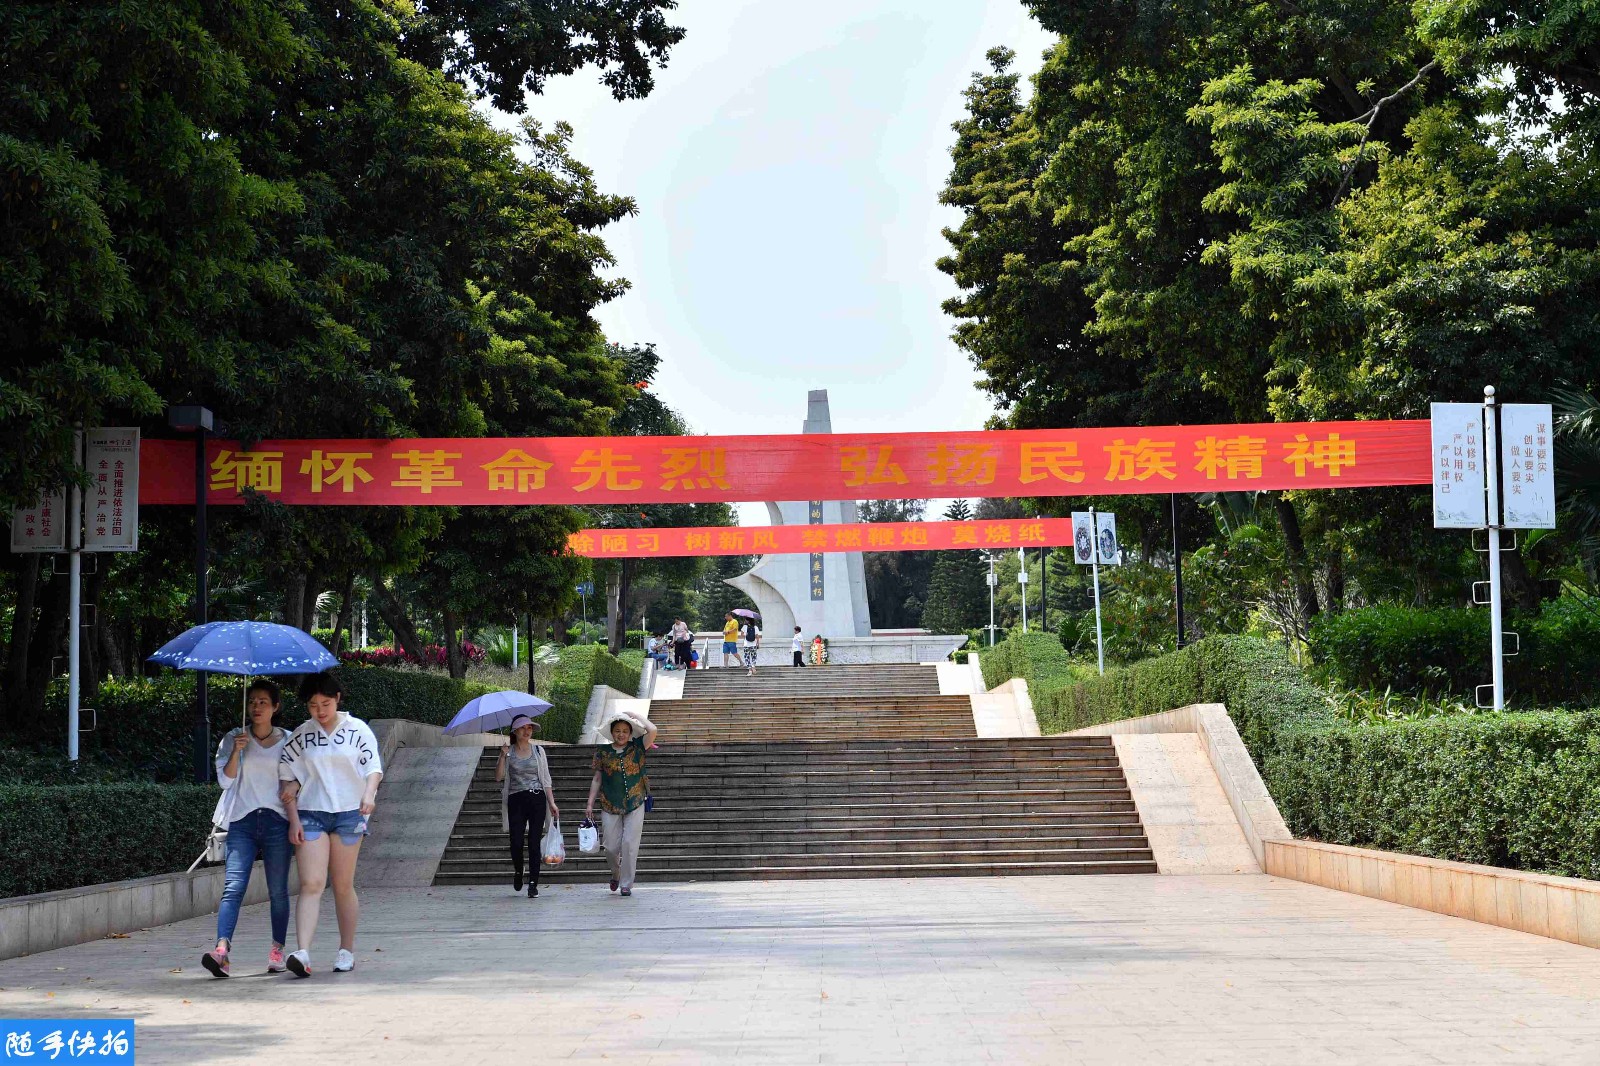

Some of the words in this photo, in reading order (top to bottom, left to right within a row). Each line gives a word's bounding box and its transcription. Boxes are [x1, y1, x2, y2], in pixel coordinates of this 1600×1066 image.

[210, 447, 732, 494] 缅怀革命先烈
[840, 432, 1356, 488] 弘扬民族精神
[1440, 444, 1451, 494] 严以律己
[1453, 433, 1463, 483] 严以用权
[1467, 422, 1476, 472] 严以修身
[1510, 445, 1522, 495] 做人要实
[1523, 434, 1534, 483] 创业要实
[1536, 423, 1547, 472] 谋事要实
[96, 460, 108, 536] 全面从严治党
[112, 460, 124, 536] 全面推进依法治国
[25, 514, 36, 537] 改革
[684, 530, 779, 551] 树新风
[802, 527, 928, 548] 禁燃鞭炮
